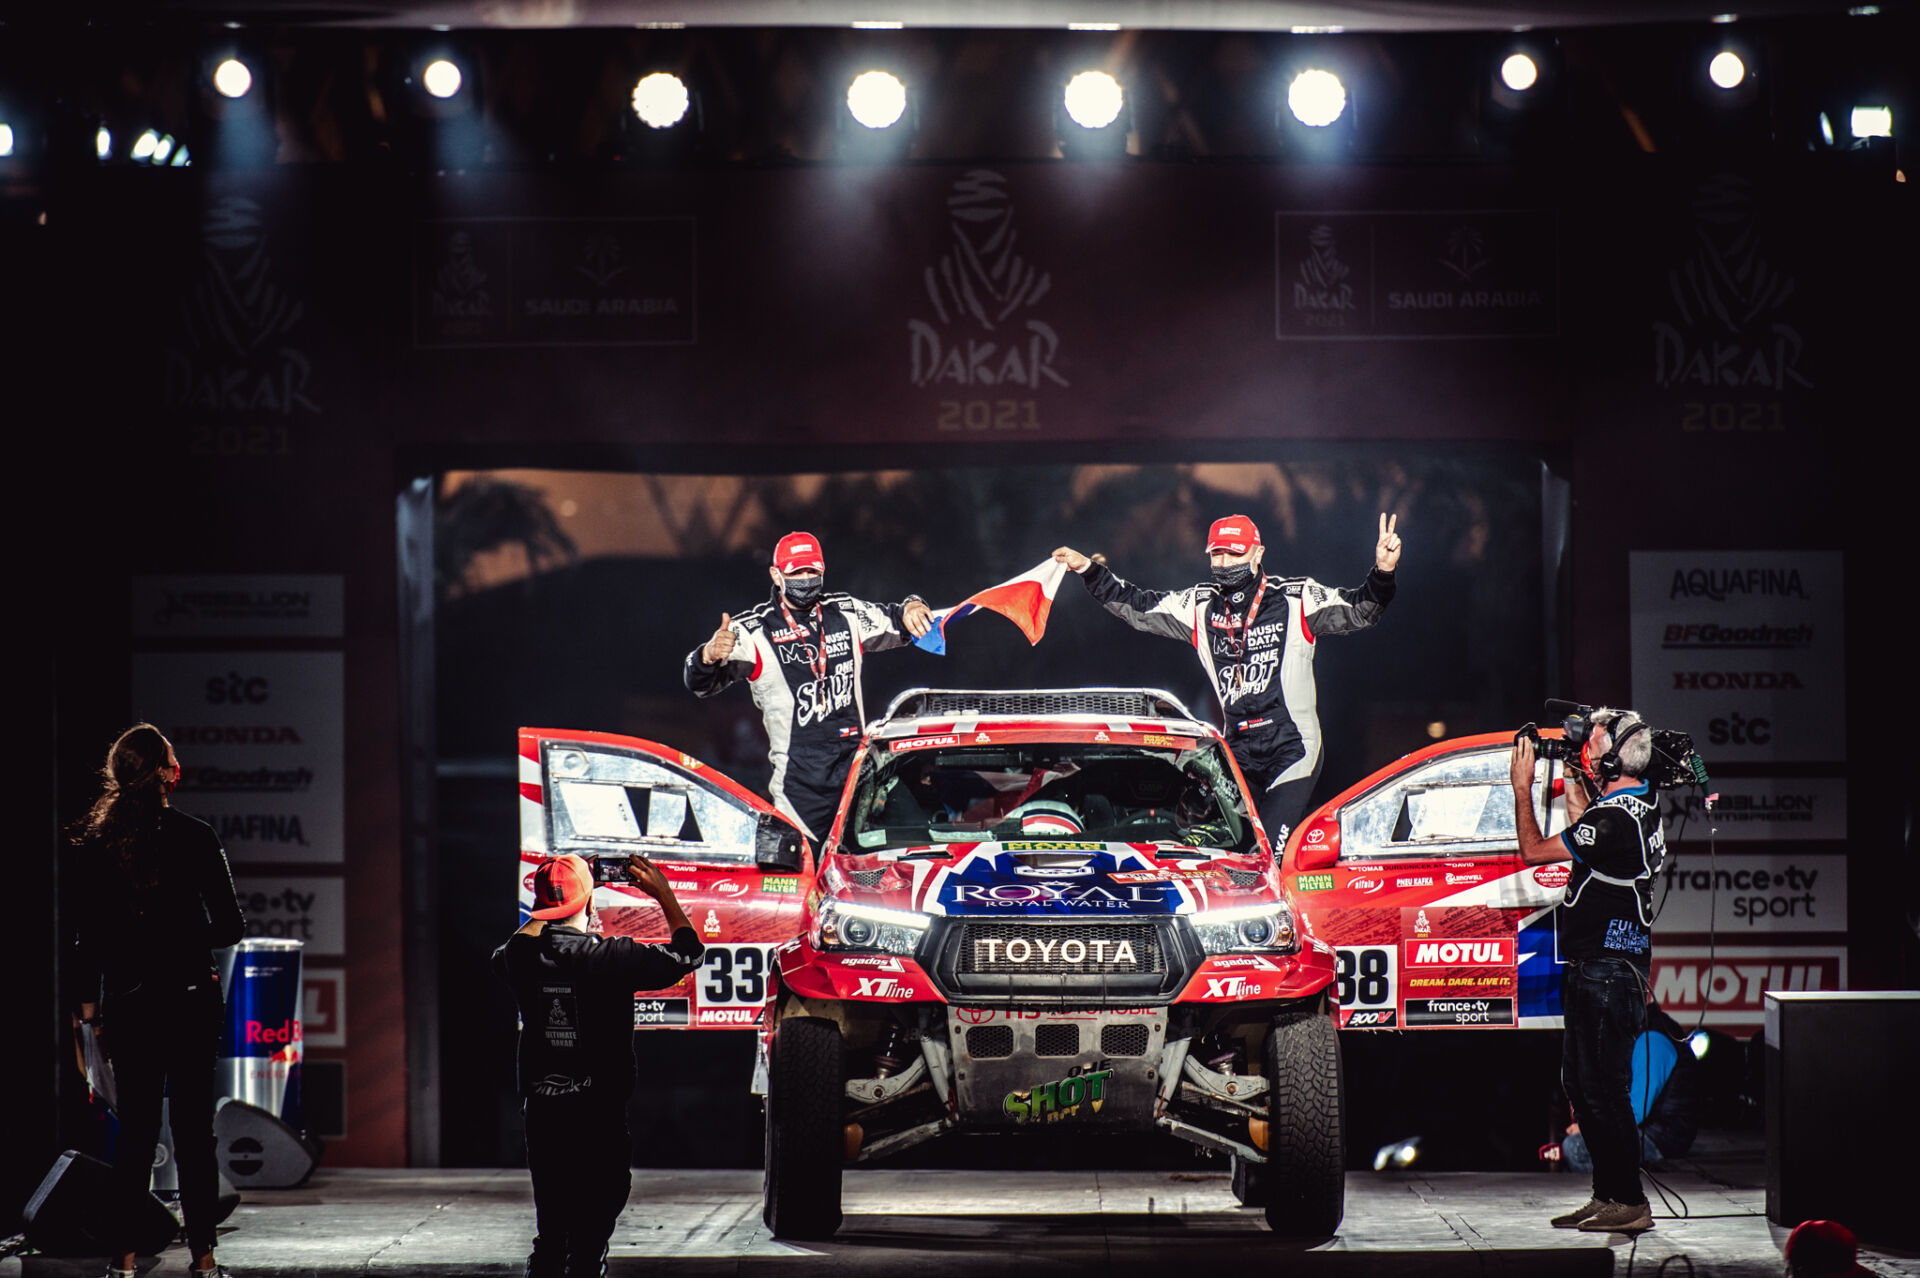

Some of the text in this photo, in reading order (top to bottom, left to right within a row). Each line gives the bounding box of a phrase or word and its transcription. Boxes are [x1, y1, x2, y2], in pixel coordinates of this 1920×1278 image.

[525, 297, 679, 316] SAUDI ARABIA
[1388, 290, 1543, 310] SAUDI ARABIA
[908, 318, 1070, 390] DAKAR
[1652, 320, 1815, 390] DAKAR
[937, 400, 1041, 431] 2021
[1681, 402, 1787, 432] 2021
[1670, 568, 1810, 601] AQUAFINA
[1247, 623, 1284, 638] MUSIC
[1663, 623, 1814, 642] BFGoodrich
[826, 641, 850, 654] DATA
[1248, 634, 1280, 647] DATA
[1250, 648, 1279, 663] ONE
[205, 671, 268, 704] stc
[1672, 671, 1806, 690] HONDA
[171, 725, 302, 745] HONDA
[1708, 711, 1771, 746] stc
[896, 737, 955, 750] MOTUL
[764, 877, 797, 886] MANN
[1298, 874, 1332, 883] MANN
[1300, 881, 1333, 891] FILTER
[763, 884, 797, 893] FILTER
[952, 884, 1164, 903] ROYAL
[986, 900, 1130, 909] ROYAL WATER
[1733, 893, 1815, 925] sport
[246, 916, 312, 941] port
[980, 939, 1137, 964] TOYOTA
[1414, 942, 1504, 963] MOTUL
[841, 957, 889, 967] agados
[1213, 958, 1256, 968] agados
[704, 946, 770, 1003] 33
[1410, 977, 1511, 987] DREAM. DARE. LIVE IT.
[851, 977, 914, 999] XTline
[1201, 976, 1262, 999] XTline
[700, 1010, 753, 1023] MOTUL
[1456, 1010, 1489, 1025] sport
[245, 1019, 290, 1045] Red
[1003, 1069, 1114, 1124] SHOT
